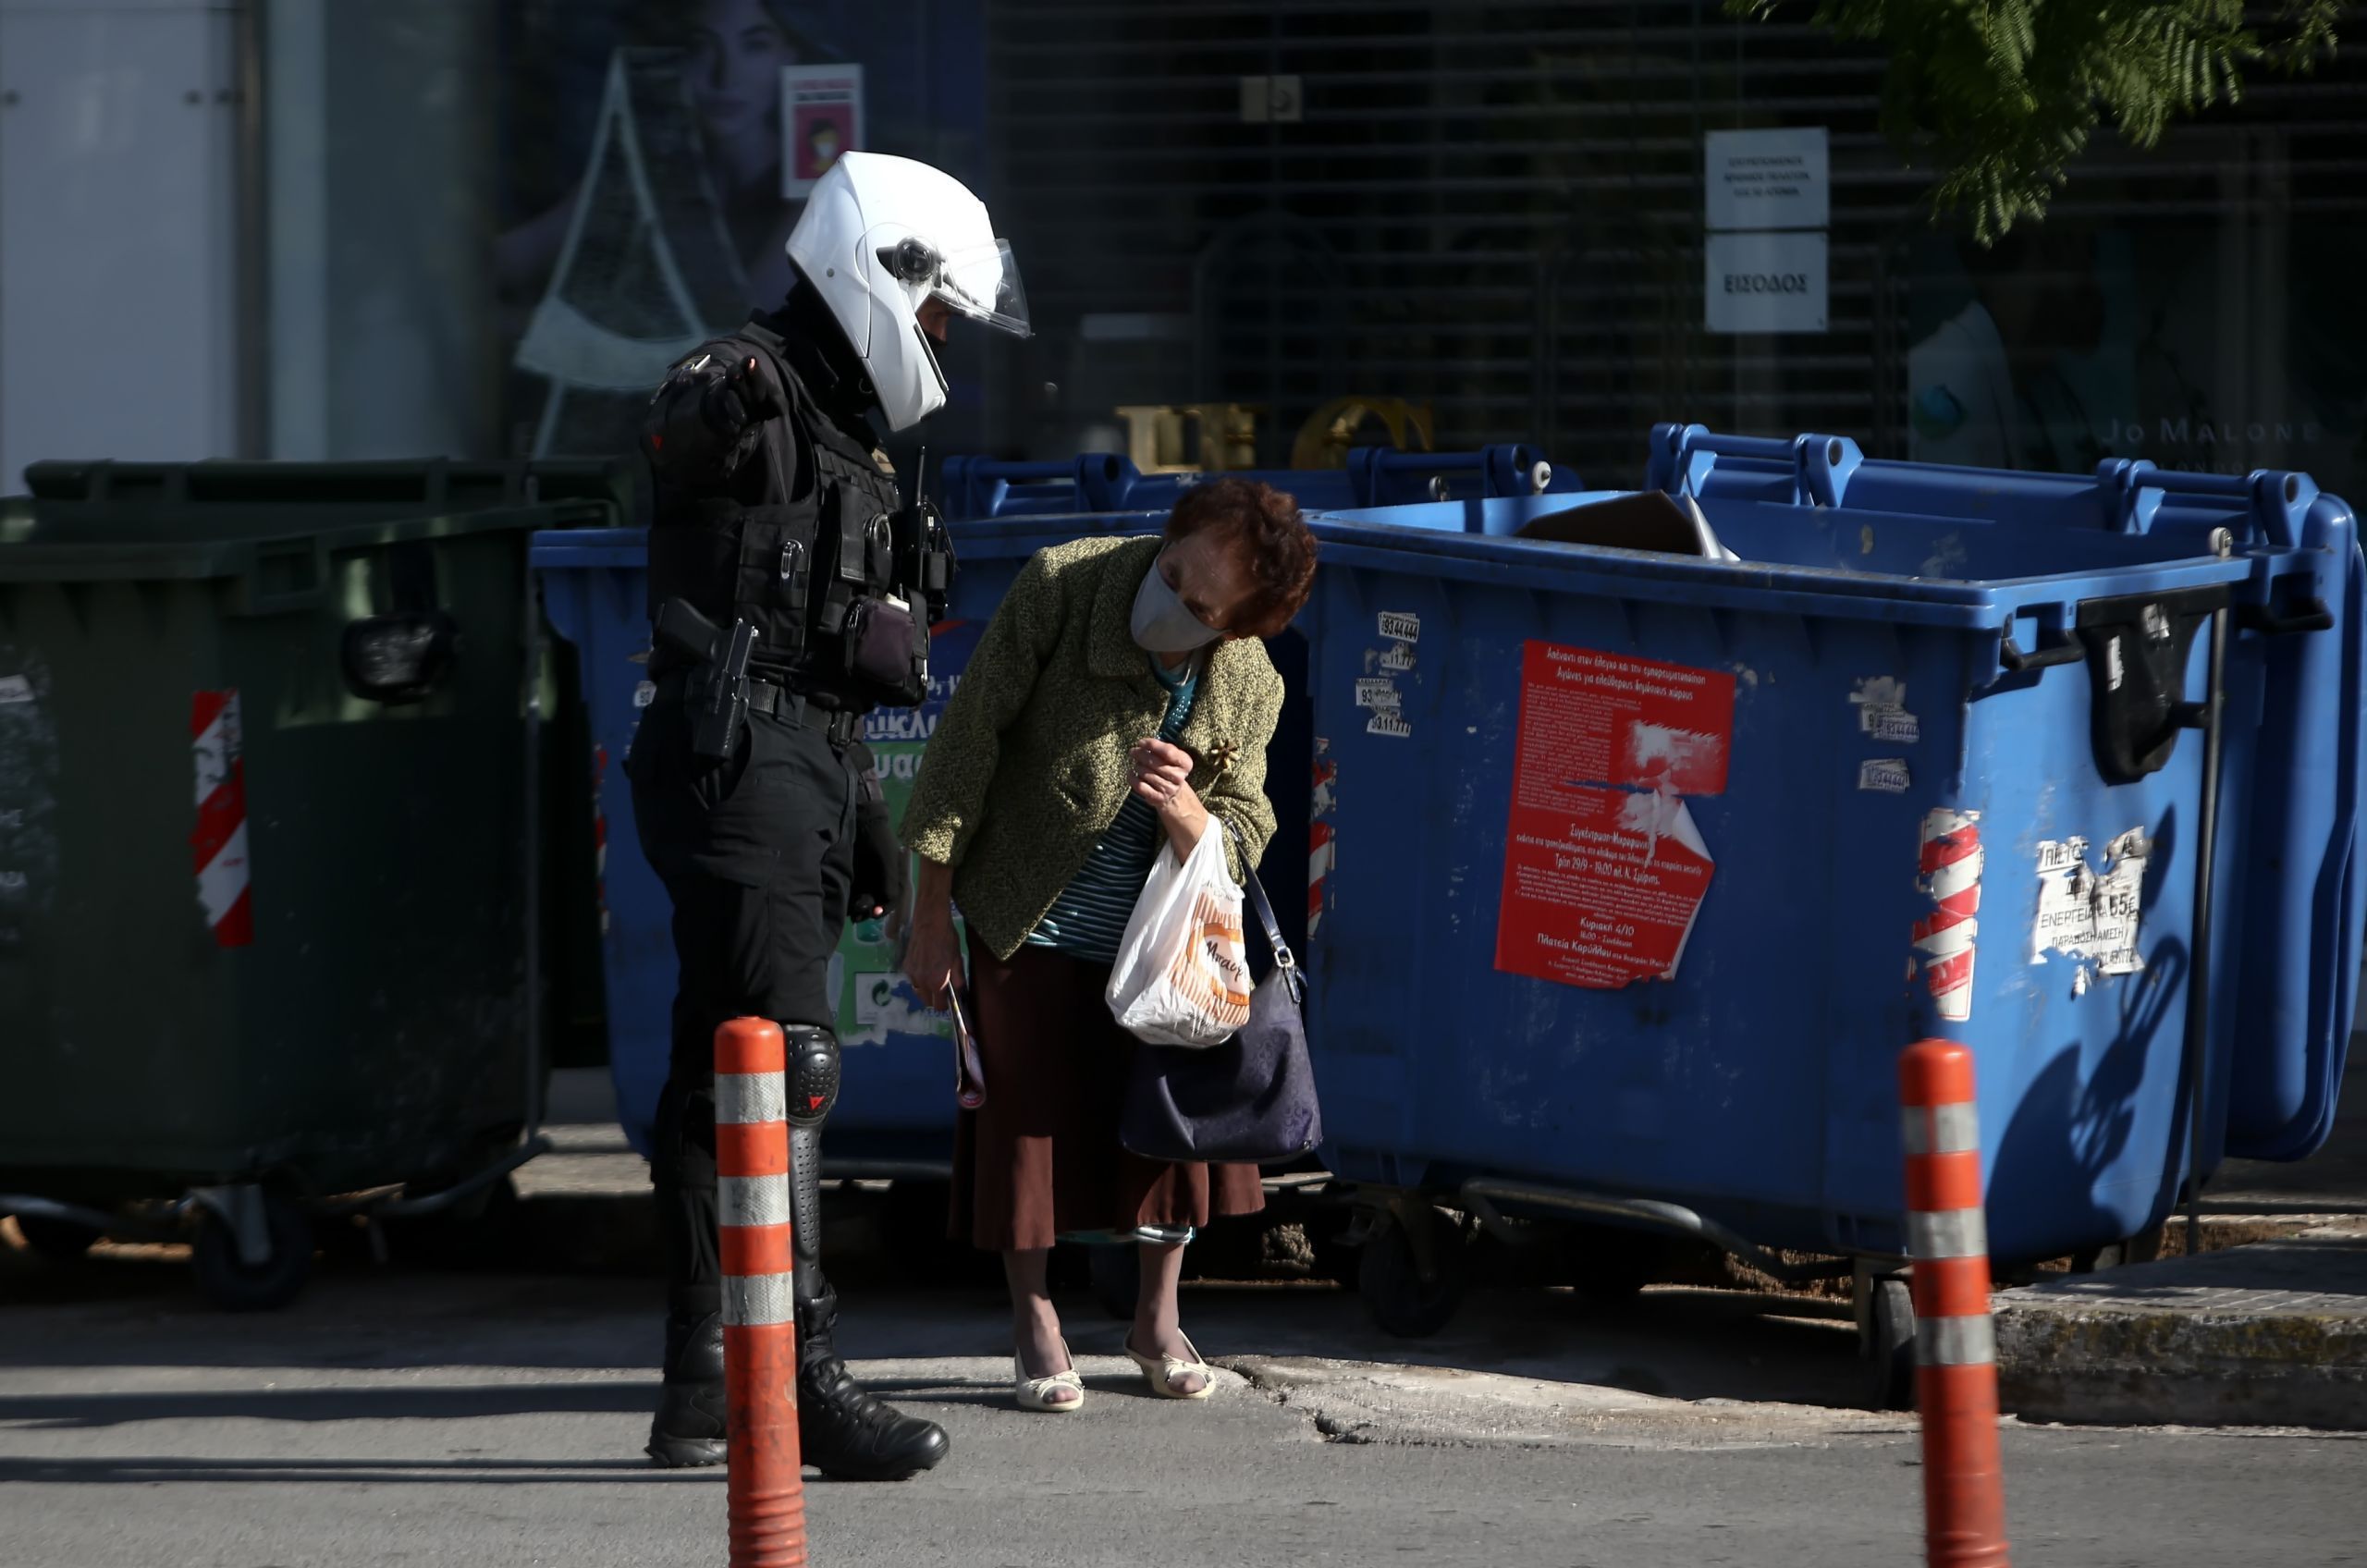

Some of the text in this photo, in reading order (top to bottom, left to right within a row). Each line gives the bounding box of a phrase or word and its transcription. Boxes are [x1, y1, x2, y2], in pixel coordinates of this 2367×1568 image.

[1723, 274, 1806, 294] ΕΙΣΟΔΟΣ
[2159, 416, 2321, 445] MALONE
[1555, 852, 1571, 869] Τρίτη
[1572, 855, 1588, 872] 29/9
[1579, 916, 1635, 936] Κυριακή 4/10
[2097, 926, 2124, 940] ΑΜΕΣΗ
[1538, 932, 1569, 950] Πλατεία
[1571, 938, 1612, 958] Καρύλλου
